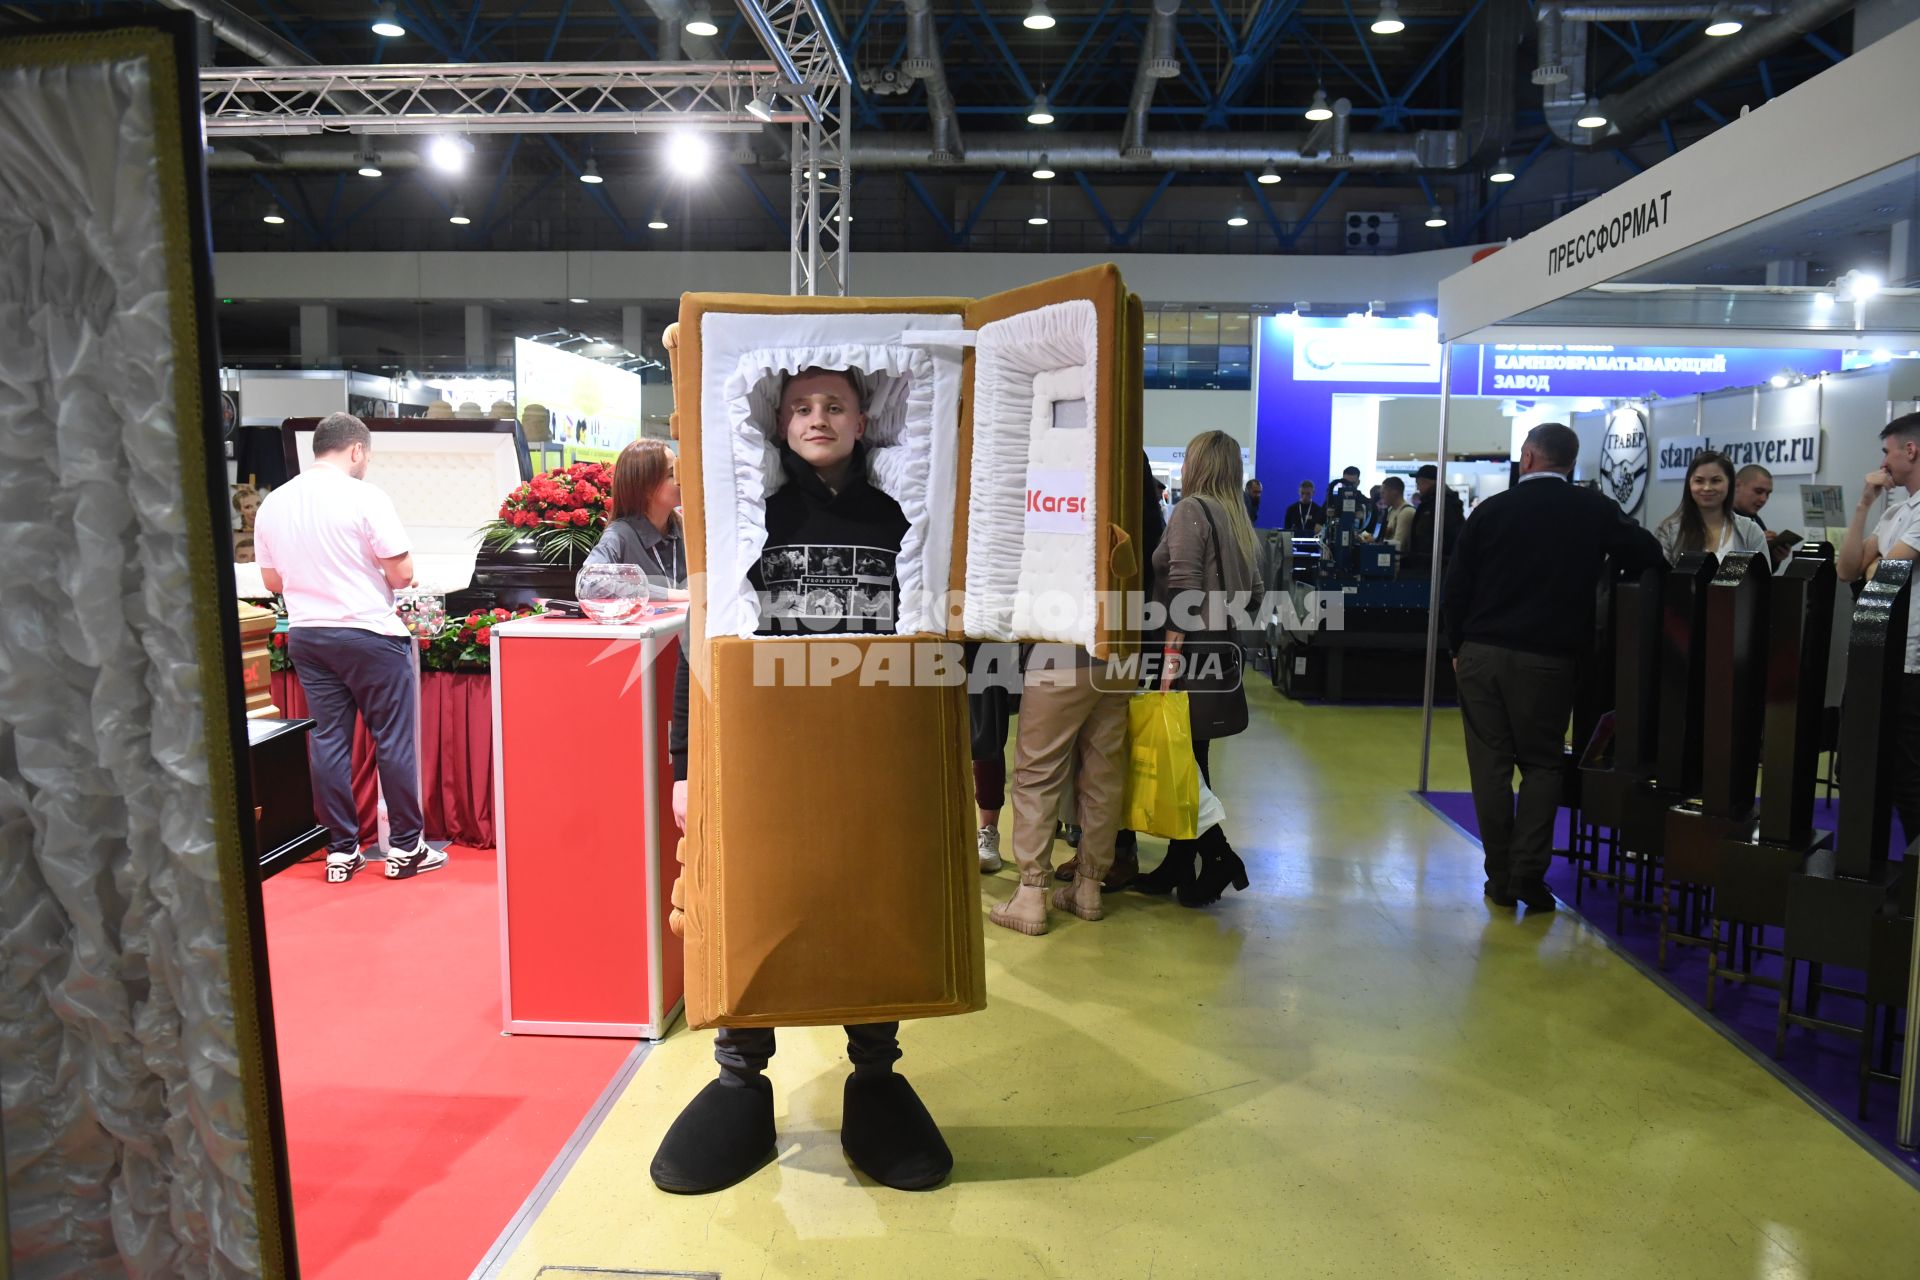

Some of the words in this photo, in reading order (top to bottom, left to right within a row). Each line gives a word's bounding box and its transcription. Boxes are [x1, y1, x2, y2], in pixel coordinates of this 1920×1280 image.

[1549, 190, 1672, 276] ПРЕССФОРМАТ
[1494, 354, 1727, 376] КАМНЕОБРАБАТЫВАЮЩИЙ
[1494, 374, 1551, 393] ЗАВОД
[1608, 428, 1645, 449] ГРАВЁР
[327, 866, 348, 882] DG
